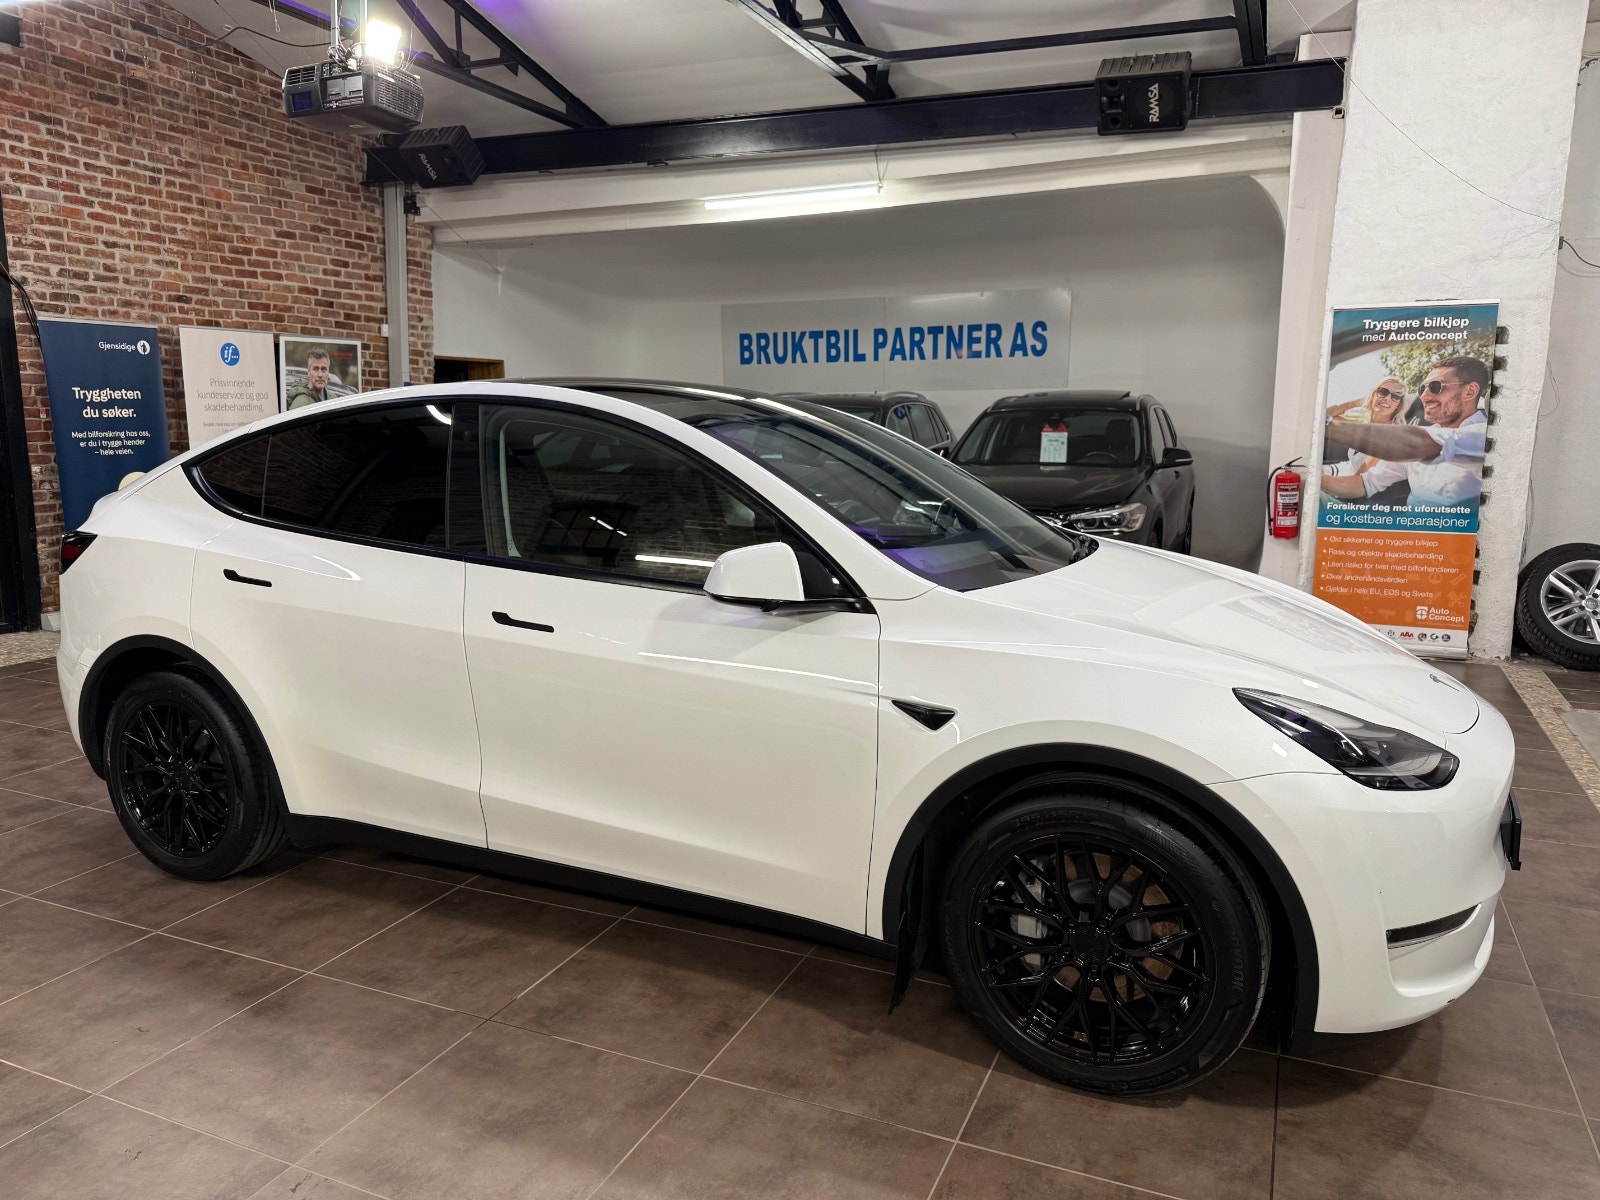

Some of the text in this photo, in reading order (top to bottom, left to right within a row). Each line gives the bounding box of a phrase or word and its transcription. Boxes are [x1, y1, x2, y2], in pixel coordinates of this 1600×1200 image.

[1148, 82, 1160, 123] RAMSA
[1363, 316, 1470, 331] Tryggere bilkjøp
[1362, 331, 1468, 342] med AutoConcept
[98, 341, 136, 352] Gjensidige
[739, 320, 1048, 365] BRUKTBIL PARTNER AS
[209, 378, 255, 388] Prisvinnende
[72, 387, 142, 402] Tryggheten
[197, 391, 245, 400] kundeservice
[256, 391, 269, 401] god
[83, 406, 137, 418] du søker.
[102, 440, 123, 448] trygge
[1326, 502, 1471, 514] Forsikrer deg mot uforutsette
[1326, 513, 1470, 528] og kostbare reparasjoner
[1343, 536, 1373, 544] sikkerhet
[1385, 539, 1414, 547] tryggere
[1384, 552, 1444, 561] skadebehandling
[1429, 614, 1465, 623] Concept
